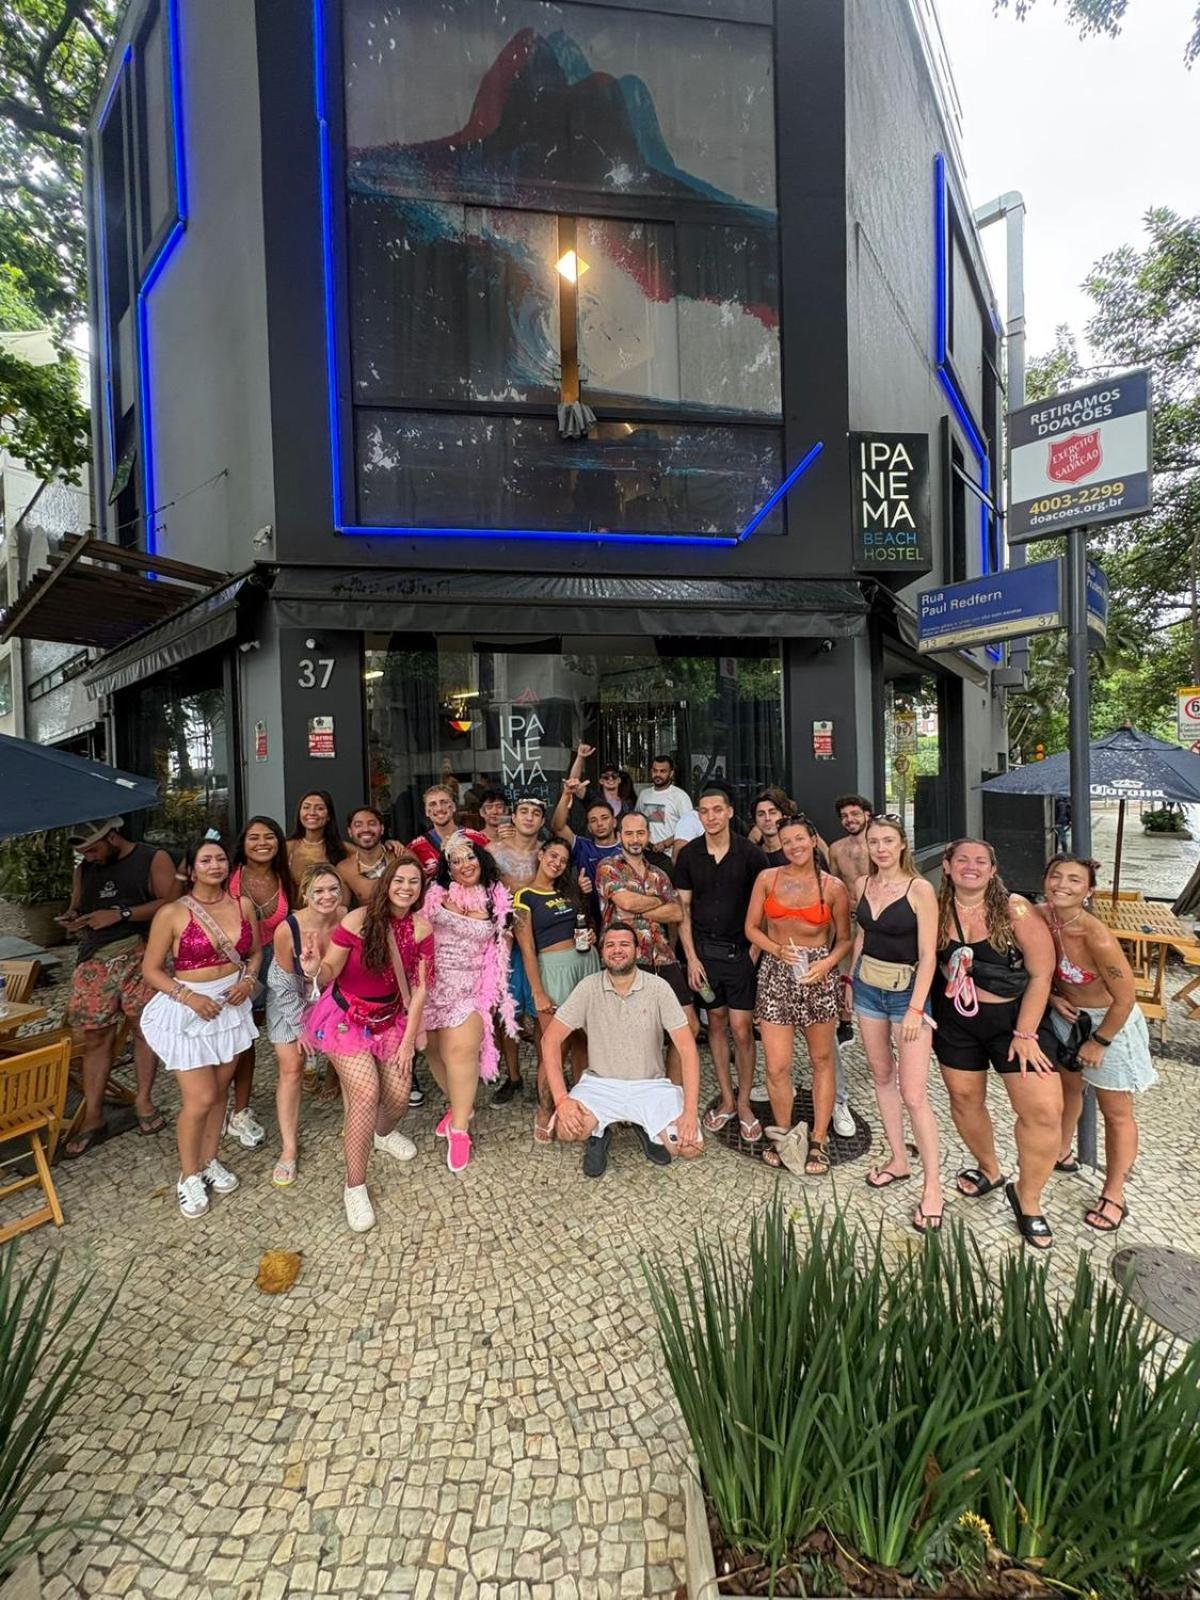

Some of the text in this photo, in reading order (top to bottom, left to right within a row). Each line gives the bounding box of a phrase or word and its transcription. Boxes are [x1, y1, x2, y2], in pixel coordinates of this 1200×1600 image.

[1030, 388, 1120, 426] RETIRAMOS
[1037, 403, 1113, 436] DOAÇÕES
[860, 442, 914, 471] IPA
[1068, 451, 1081, 464] DE
[861, 471, 909, 499] NE
[1029, 482, 1125, 515] 4003-2299
[862, 500, 916, 529] MA
[1029, 497, 1124, 525] doacoes.org.br
[863, 531, 917, 545] BEACH
[864, 547, 924, 561] HOSTEL
[921, 592, 944, 606] Rua
[921, 591, 1003, 618] Paul Redfern
[298, 659, 335, 689] 37
[499, 713, 545, 738] IPA
[501, 736, 542, 761] NE
[502, 761, 547, 786] MA
[1089, 783, 1168, 798] Corona
